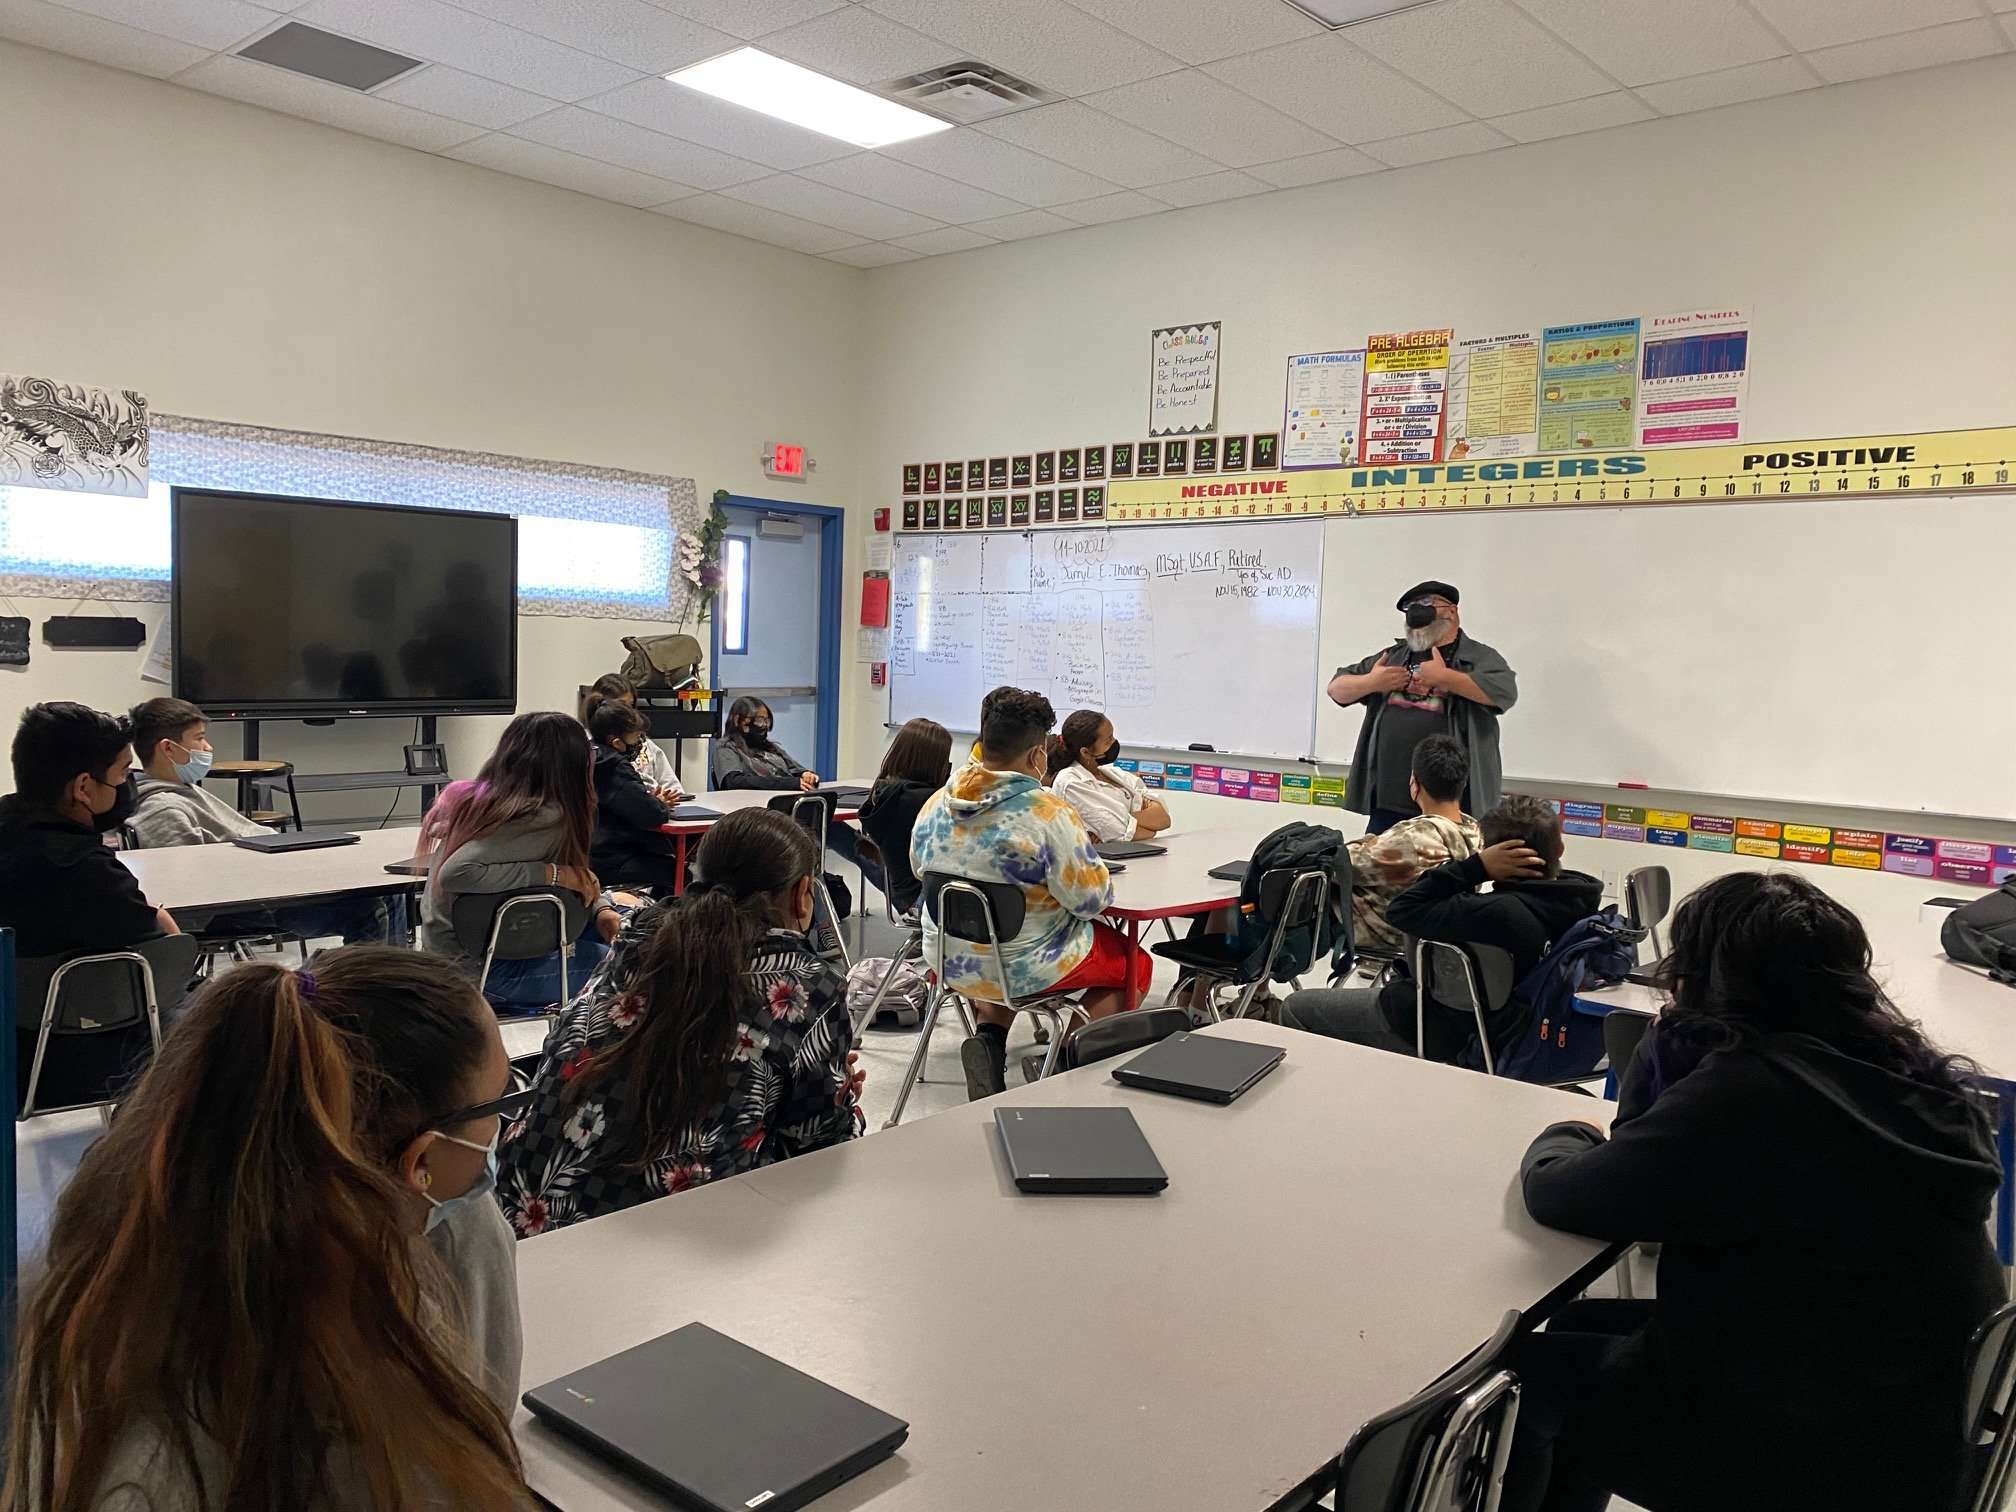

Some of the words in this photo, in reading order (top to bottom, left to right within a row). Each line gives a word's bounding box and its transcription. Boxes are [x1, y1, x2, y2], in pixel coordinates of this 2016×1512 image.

[1548, 327, 1574, 335] RATIOS
[1583, 320, 1635, 331] PROPORTIONS
[1460, 338, 1487, 346] FACTORS
[1495, 333, 1530, 342] MULTIPLES
[1297, 356, 1319, 365] MATH
[1321, 353, 1362, 363] FORMULAS
[1376, 351, 1396, 359] ORDER
[1408, 348, 1442, 356] OPERATION
[1158, 358, 1170, 368] Be
[1157, 370, 1169, 381] Be
[1172, 366, 1210, 380] Prepared
[1157, 384, 1168, 395] Be
[1156, 398, 1167, 409] Be
[1170, 394, 1197, 408] Honest
[1395, 416, 1431, 424] Multiplication
[776, 445, 802, 473] EXIT
[1743, 445, 1915, 472] POSITIVE
[1352, 456, 1647, 488] INTEGERS
[1163, 508, 1172, 518] -17
[1195, 506, 1204, 516] -15
[1212, 506, 1221, 515] -14
[1229, 505, 1239, 515] -13
[1246, 503, 1256, 514] -12
[1264, 503, 1273, 514] -11
[1282, 502, 1292, 513] -10
[1300, 501, 1308, 512] -9
[1320, 501, 1328, 511] -8
[1358, 499, 1366, 509] -6
[1378, 497, 1386, 508] -5
[1397, 496, 1405, 507] -4
[1418, 496, 1426, 507] -3
[1439, 494, 1447, 505] -2
[1460, 493, 1467, 505] -1
[1484, 493, 1491, 504] 0
[1507, 492, 1512, 503] 1
[1529, 491, 1535, 502] 2
[1553, 490, 1559, 502] 3
[1575, 489, 1581, 500] 4
[1600, 488, 1606, 500] 5
[1623, 487, 1630, 499] 6
[1649, 486, 1655, 498] 7
[1674, 485, 1681, 497] 8
[1700, 484, 1707, 496] 9
[1725, 483, 1736, 495] 10
[1752, 482, 1762, 494] 11
[1780, 480, 1790, 493] 12
[1808, 479, 1820, 492] 13
[1837, 478, 1848, 490] 14
[1868, 477, 1880, 489] 15
[1898, 475, 1910, 488] 16
[1930, 474, 1941, 486] 17
[1961, 471, 1974, 485] 18
[1994, 470, 2008, 483] 19
[1181, 480, 1288, 498] NEGATIVE
[1565, 802, 1601, 810] diagram
[1693, 816, 1733, 824] summarize
[1607, 823, 1641, 832] support
[1837, 830, 1877, 838] explain
[1896, 836, 1925, 845] justify
[1786, 844, 1826, 854] identify
[1940, 862, 1986, 871] observe
